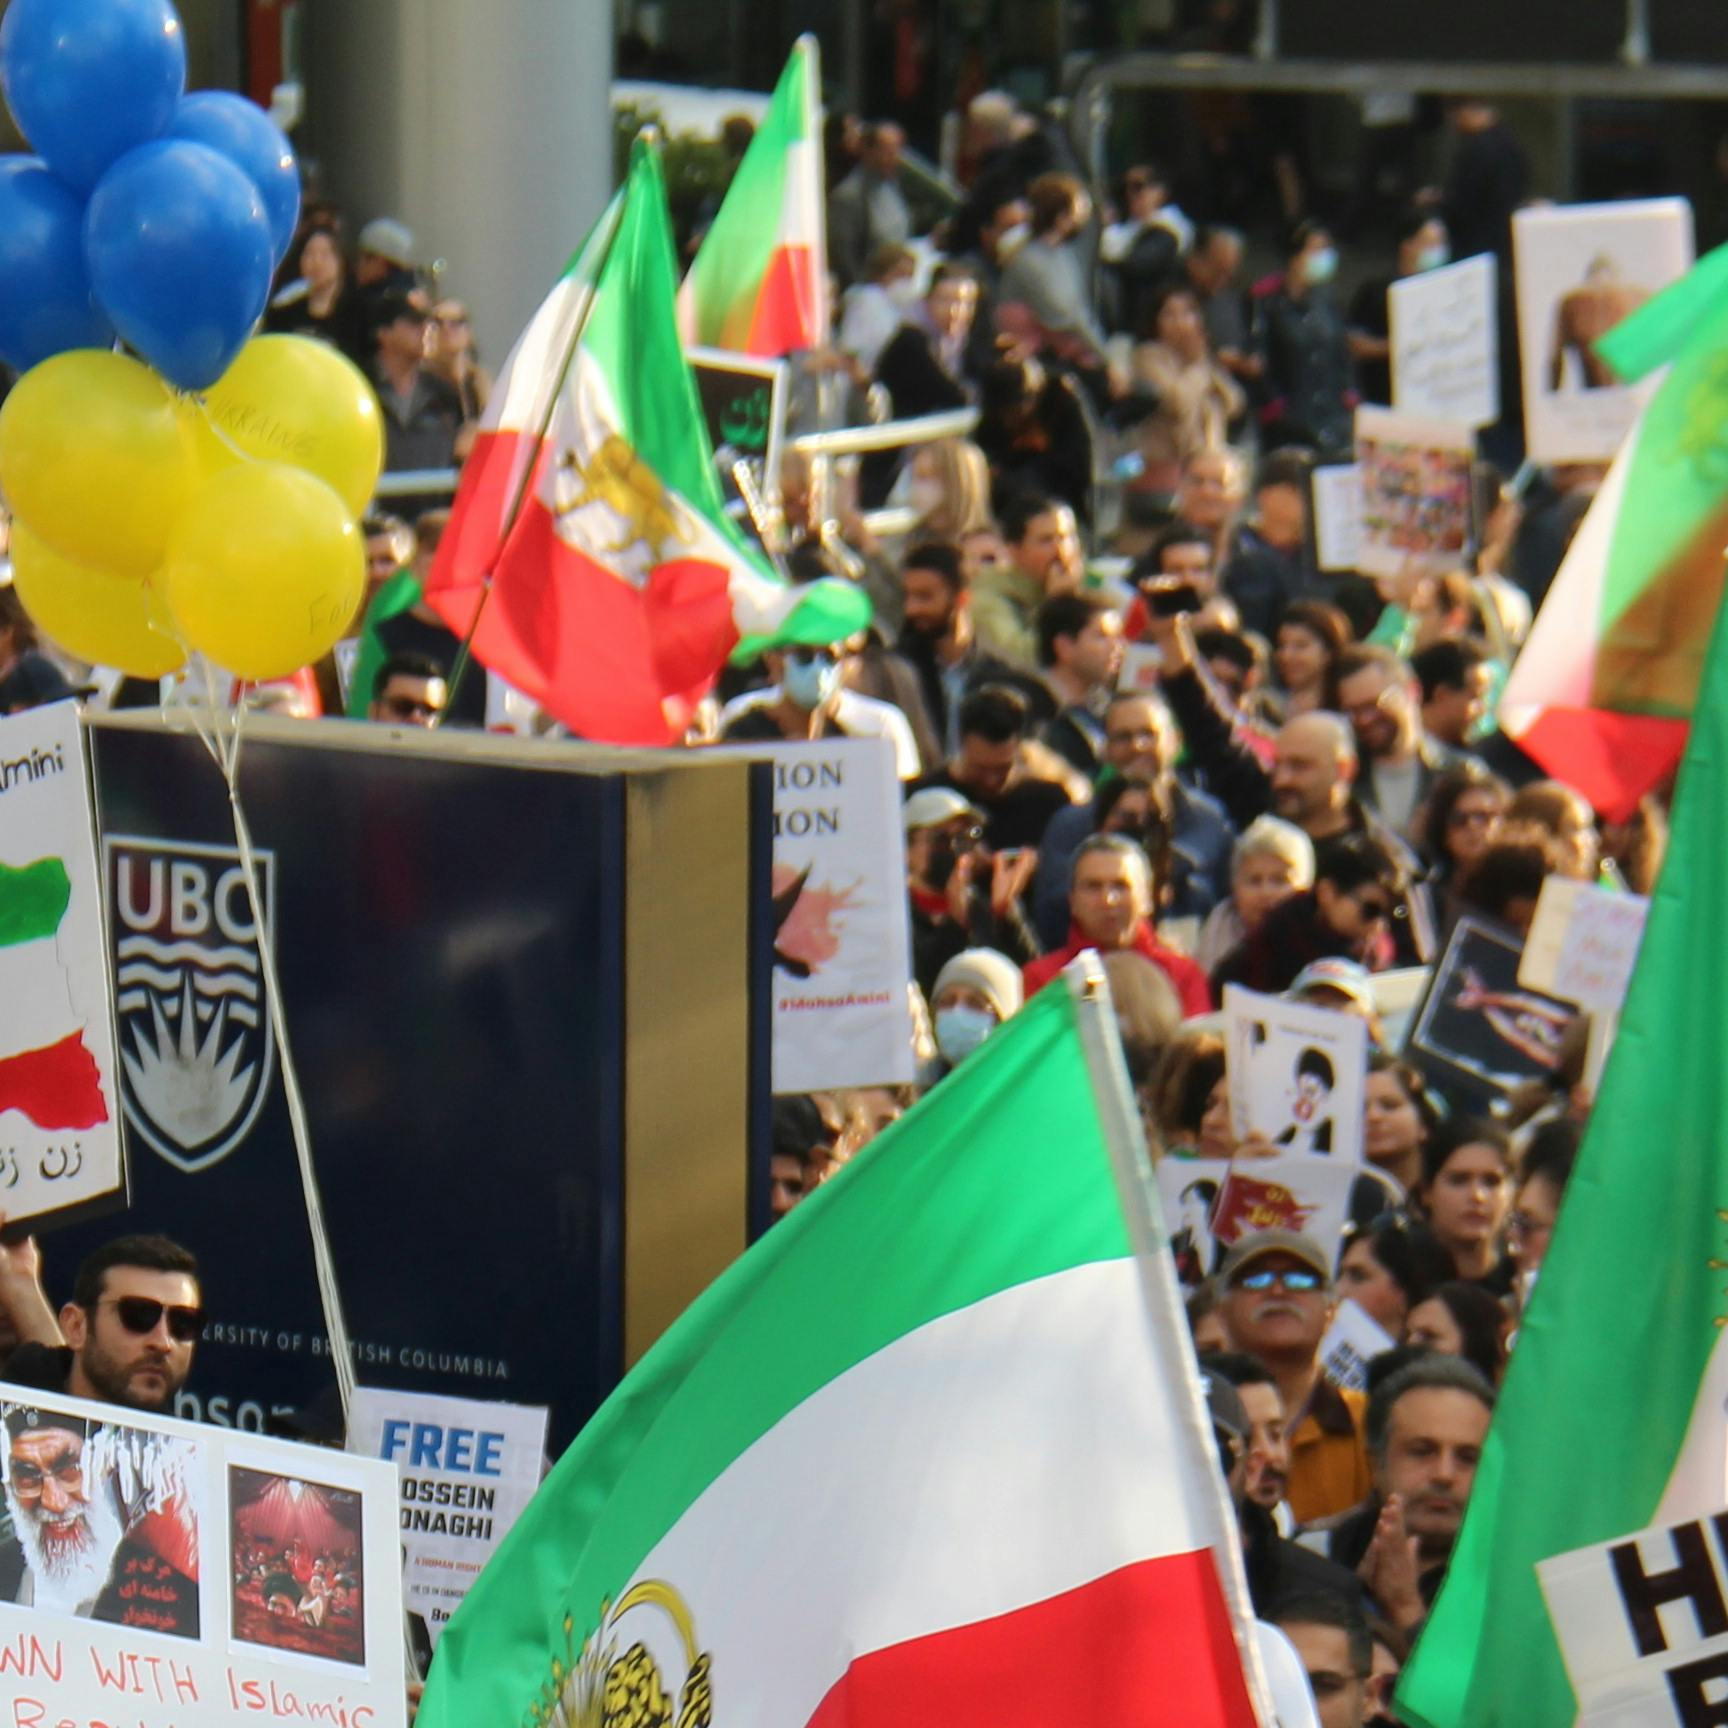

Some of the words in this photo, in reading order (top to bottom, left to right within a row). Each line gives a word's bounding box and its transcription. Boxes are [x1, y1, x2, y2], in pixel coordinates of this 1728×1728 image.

[775, 759, 844, 791] ION
[773, 805, 840, 838] ION
[116, 854, 258, 945] UBC
[38, 1140, 83, 1180] زن
[276, 1332, 301, 1352] OF
[399, 1347, 509, 1380] COLUMBIA
[380, 1418, 506, 1478] FREE
[401, 1477, 496, 1512] OSSEIN
[400, 1508, 493, 1542] ONAGHI
[90, 1646, 200, 1705] WITH
